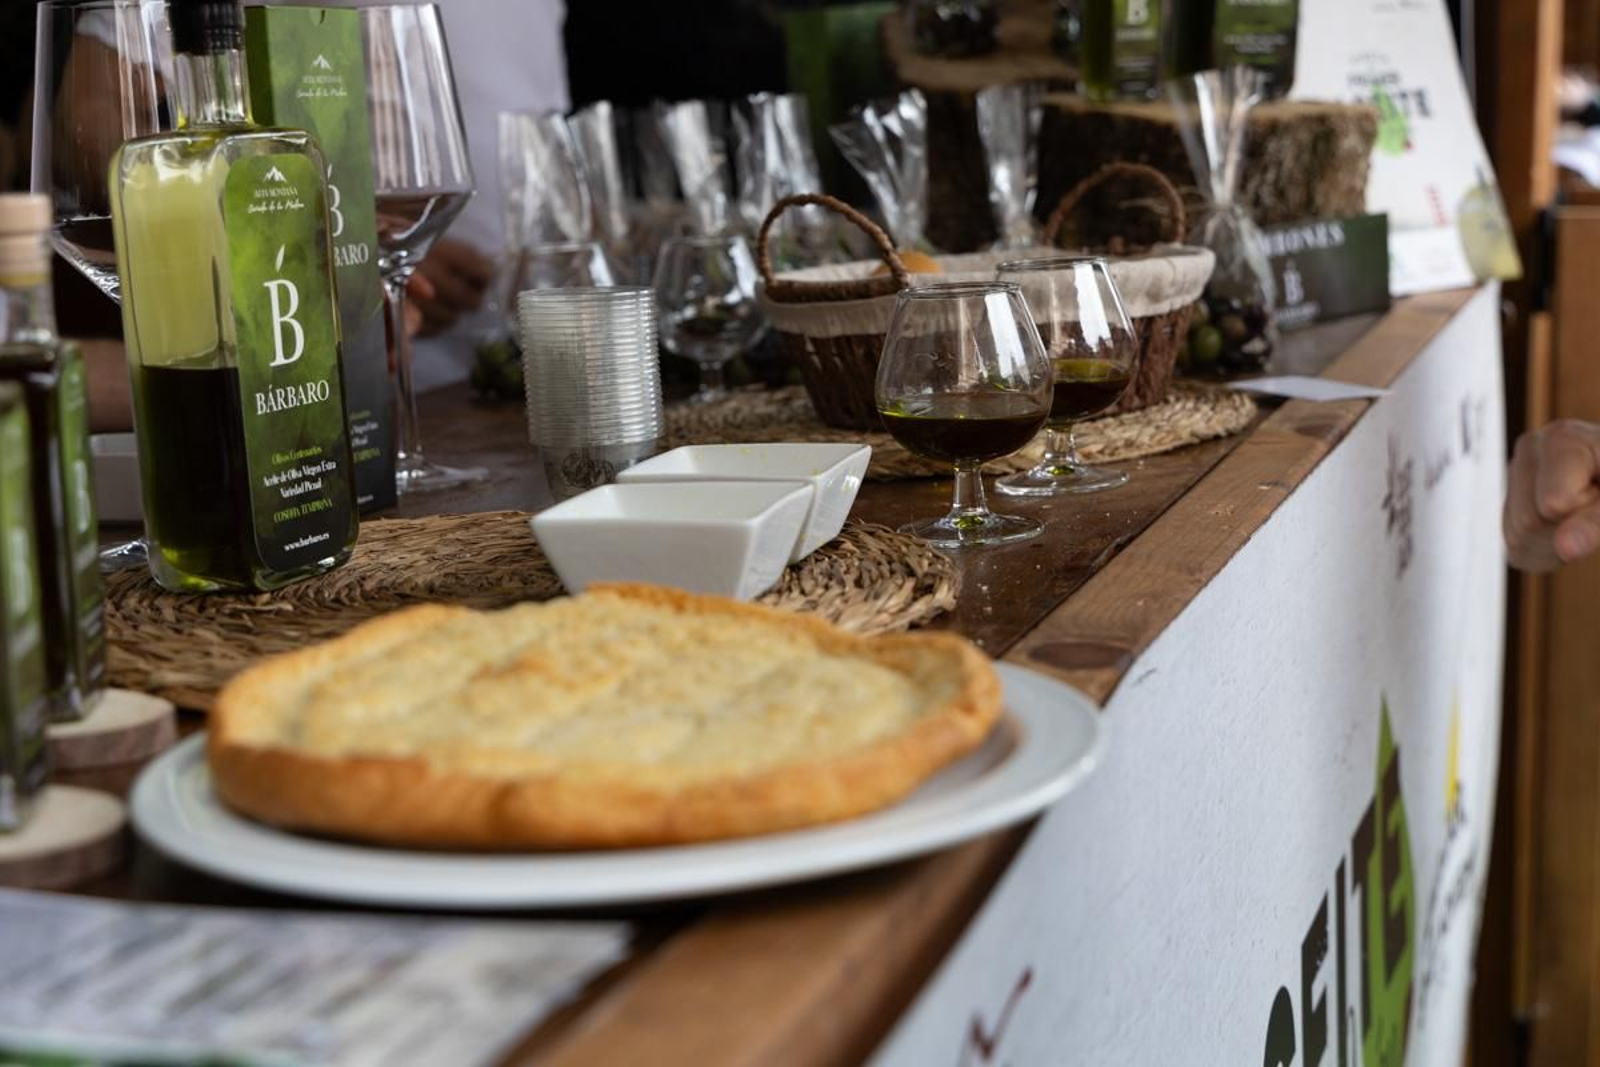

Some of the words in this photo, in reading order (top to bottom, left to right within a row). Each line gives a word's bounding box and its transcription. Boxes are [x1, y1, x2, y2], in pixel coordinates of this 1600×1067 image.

[334, 243, 369, 267] BARO
[255, 380, 330, 415] BÁRBARO
[321, 460, 337, 472] Extra
